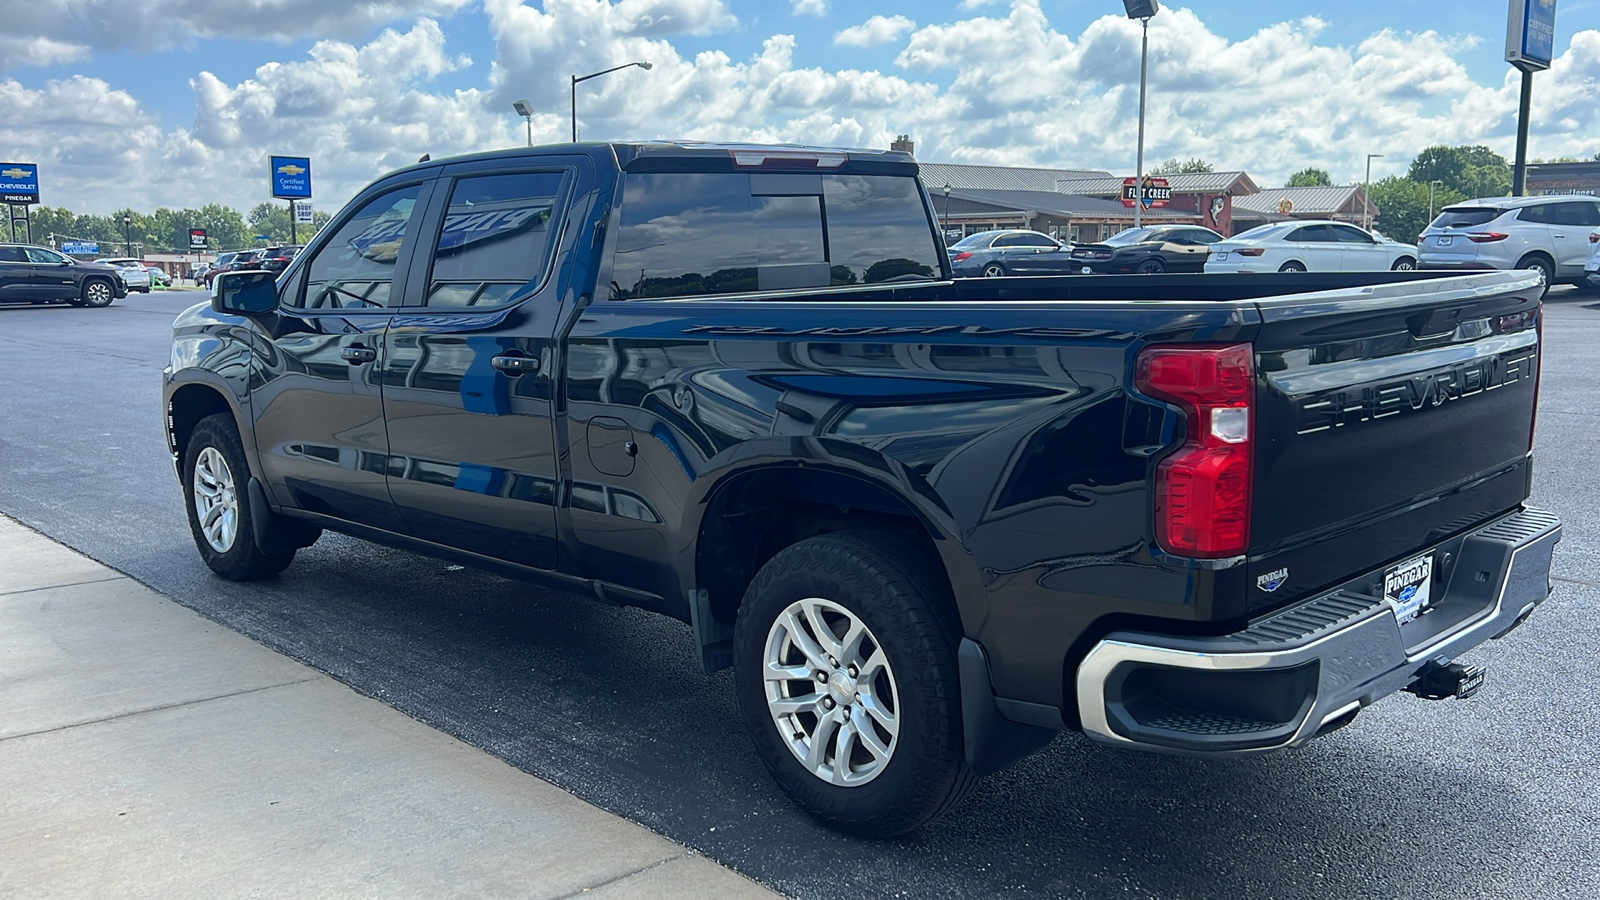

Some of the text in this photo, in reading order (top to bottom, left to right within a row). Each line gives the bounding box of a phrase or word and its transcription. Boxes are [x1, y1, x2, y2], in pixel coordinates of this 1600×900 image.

[1128, 188, 1170, 199] FLT CREEK
[1297, 354, 1536, 435] CHEVROLET
[1257, 567, 1288, 586] PINEGAR
[1387, 564, 1428, 593] PINEGAR
